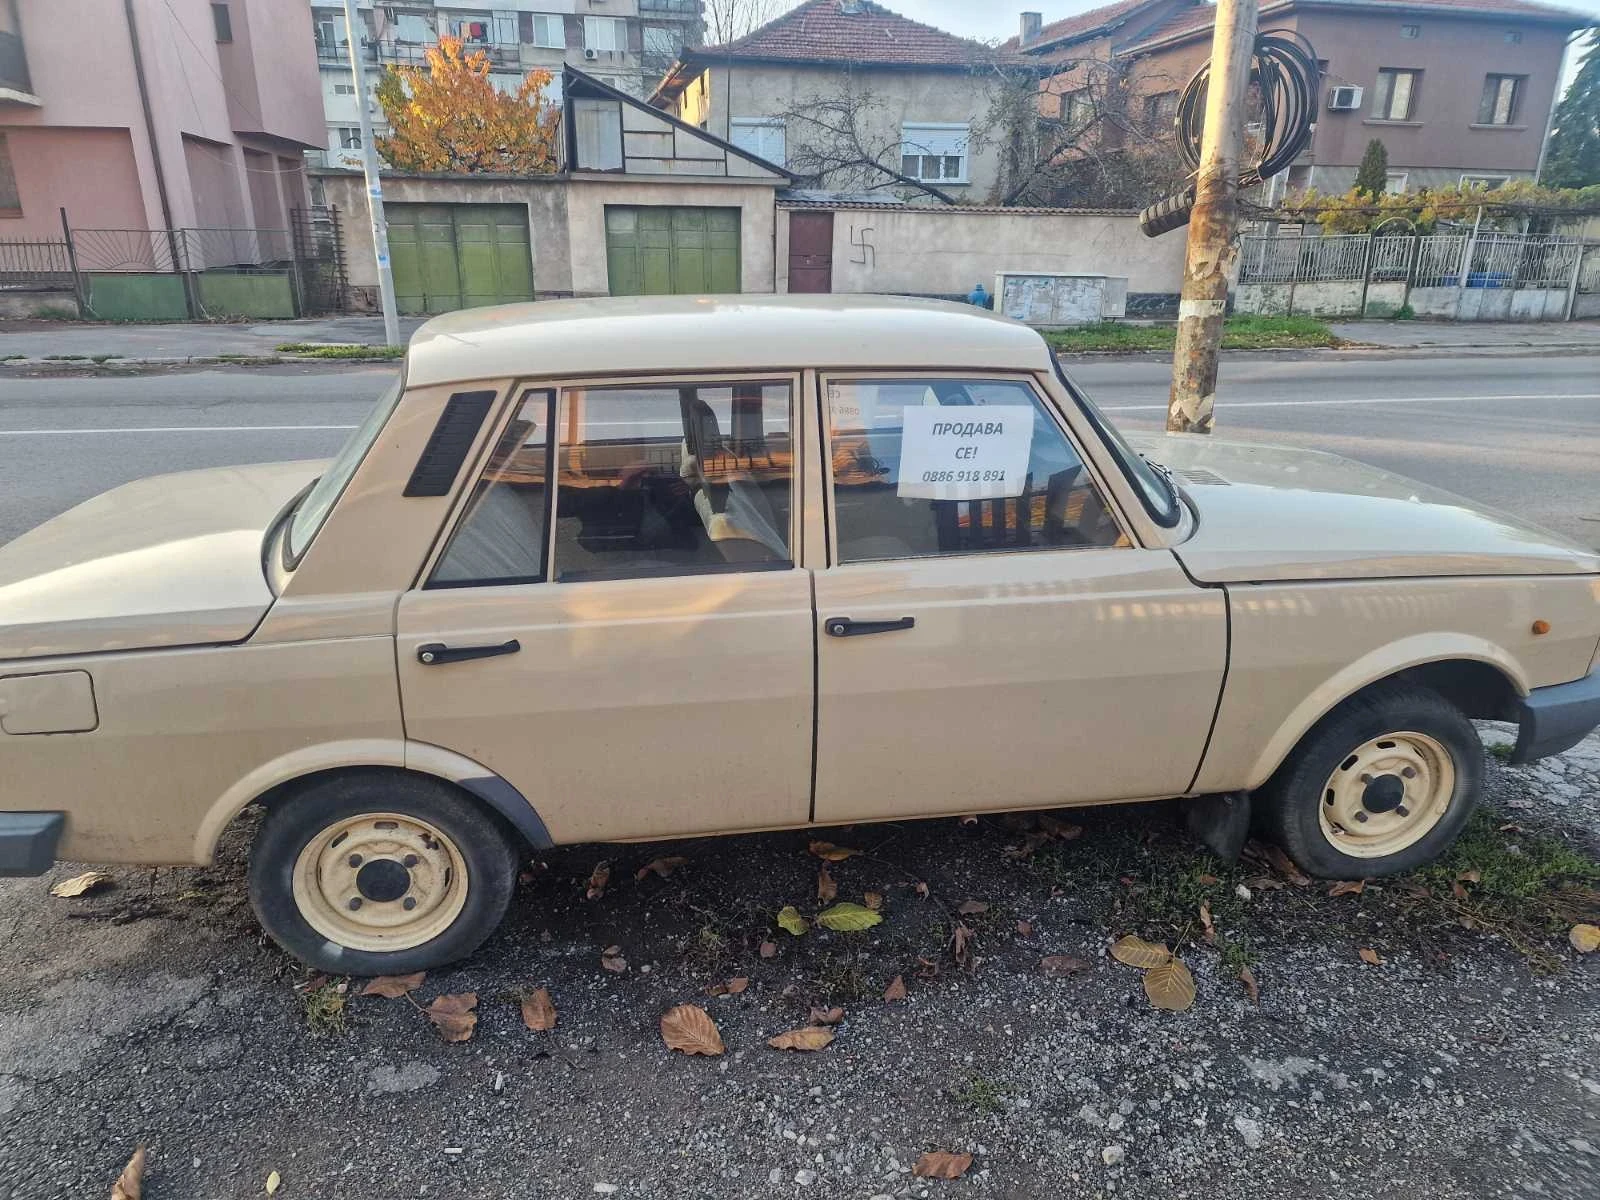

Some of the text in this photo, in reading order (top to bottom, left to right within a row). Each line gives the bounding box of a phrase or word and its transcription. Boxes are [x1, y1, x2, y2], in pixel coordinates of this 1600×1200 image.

[932, 422, 1004, 437] ПРОДАВА
[955, 447, 979, 459] СЕ!
[922, 470, 1005, 482] 0886 918 891
